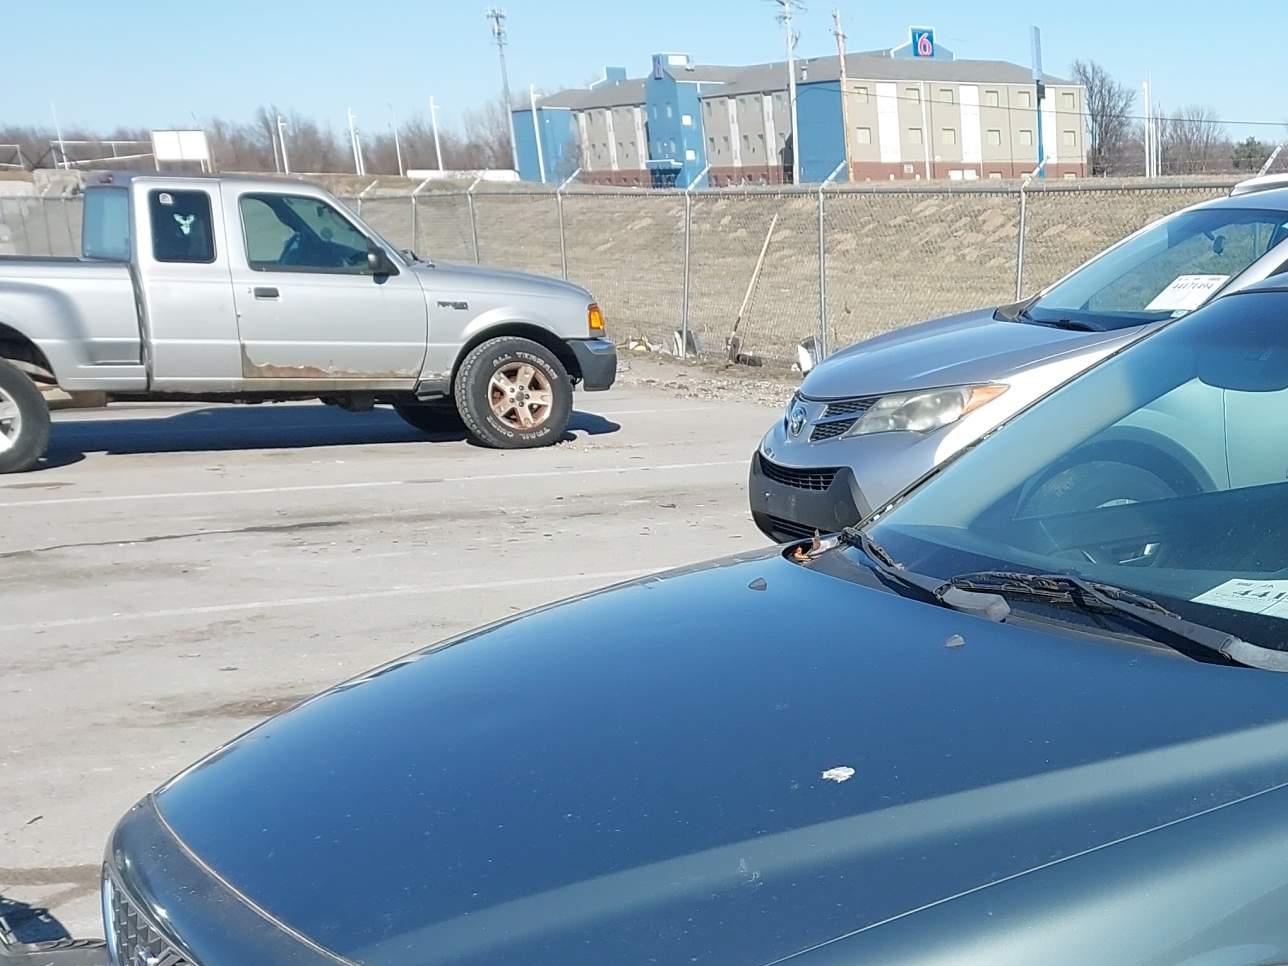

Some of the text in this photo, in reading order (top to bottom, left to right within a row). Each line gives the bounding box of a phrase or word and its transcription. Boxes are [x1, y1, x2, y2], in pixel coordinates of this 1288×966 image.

[918, 32, 933, 56] 6
[493, 354, 512, 367] ALL
[519, 426, 551, 440] TRAIL
